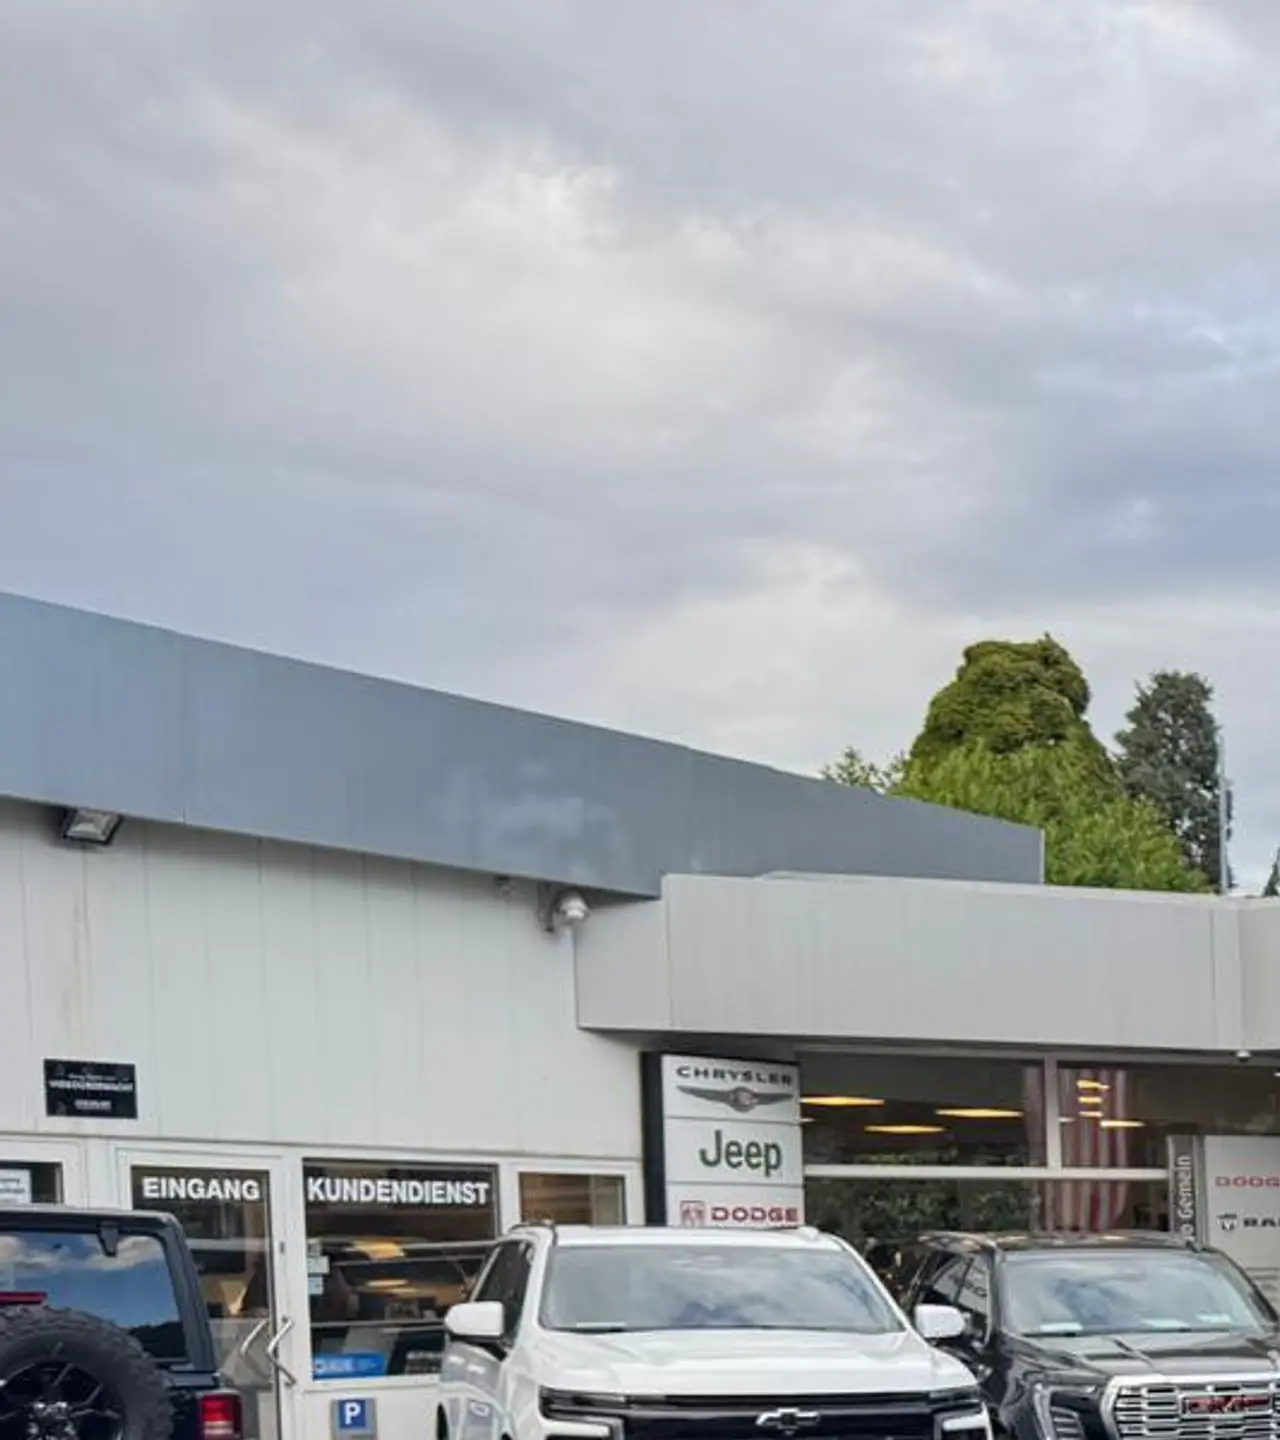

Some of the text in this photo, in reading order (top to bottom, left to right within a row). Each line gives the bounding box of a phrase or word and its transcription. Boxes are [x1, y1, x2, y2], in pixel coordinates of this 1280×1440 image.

[676, 1065, 793, 1086] CHRYSLER
[699, 1129, 782, 1178] Jeep
[142, 1176, 261, 1201] EINGANG
[307, 1177, 490, 1206] KUNDENDIENST
[711, 1206, 799, 1223] DODGE
[344, 1402, 361, 1425] P
